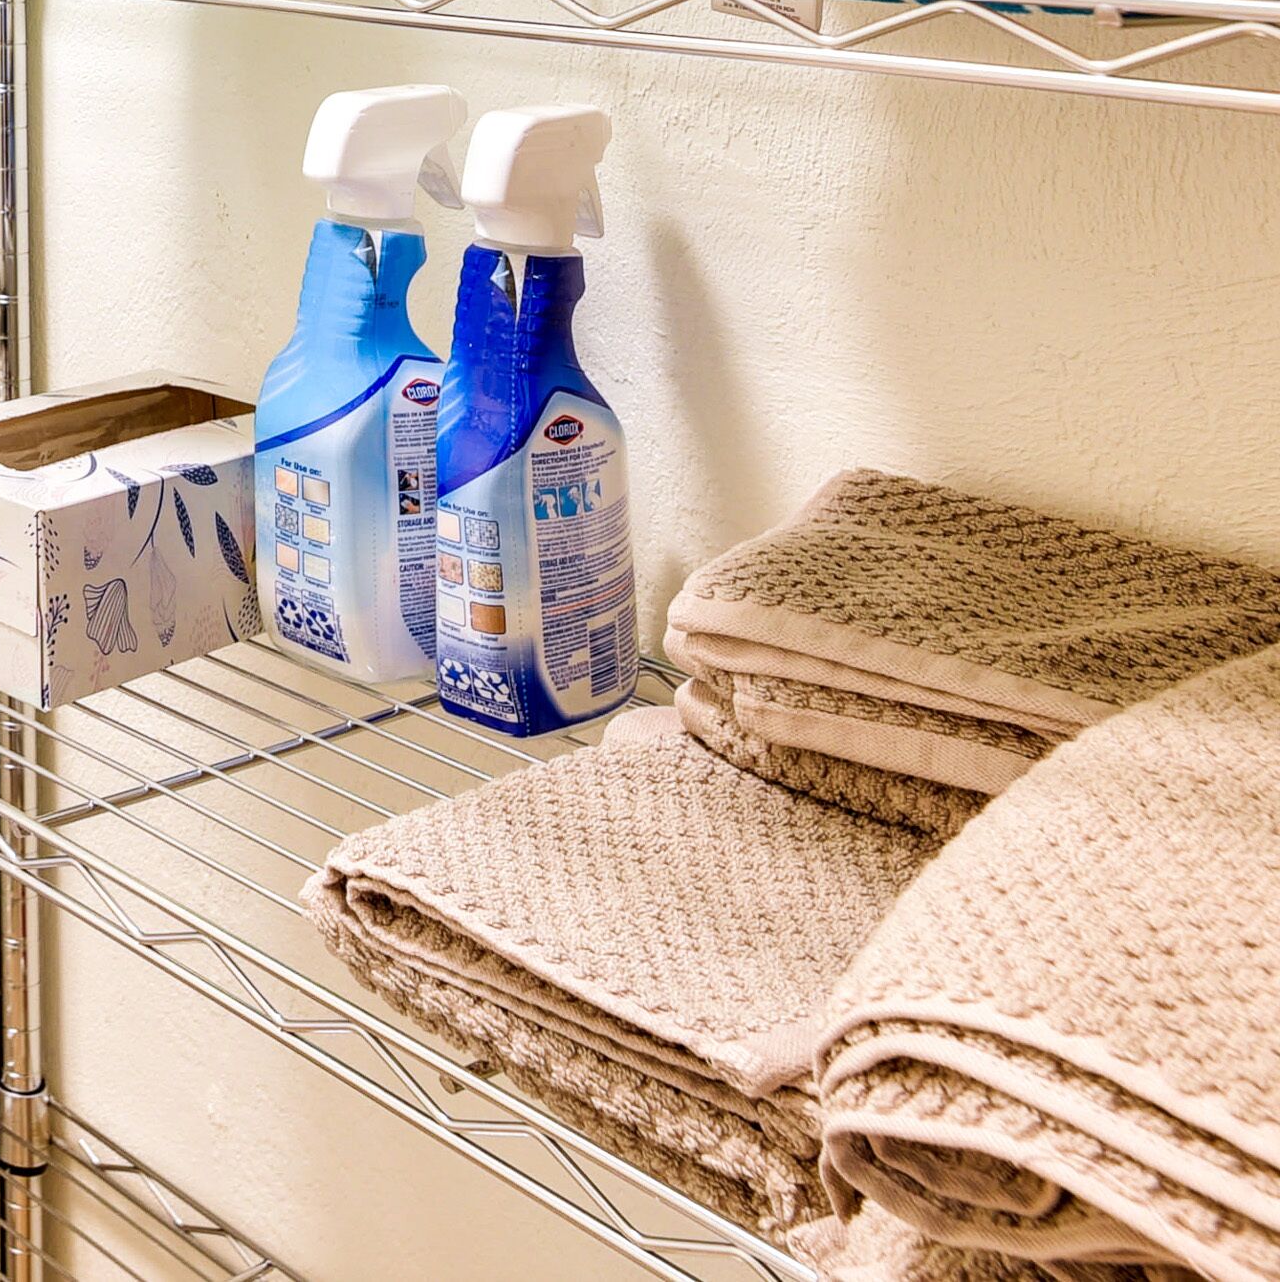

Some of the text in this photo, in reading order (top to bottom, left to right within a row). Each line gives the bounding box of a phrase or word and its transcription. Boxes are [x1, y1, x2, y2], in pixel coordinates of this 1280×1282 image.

[406, 385, 438, 399] CLOROX
[549, 422, 580, 438] CLOROX
[281, 457, 322, 477] For Use on:
[532, 457, 568, 466] DIRECTIONS
[462, 506, 476, 516] Use
[397, 517, 435, 528] STORAGE AND
[539, 558, 558, 568] STORAGE
[559, 557, 568, 565] AND
[478, 701, 513, 714] PLASTIC
[482, 707, 509, 719] LABEL
